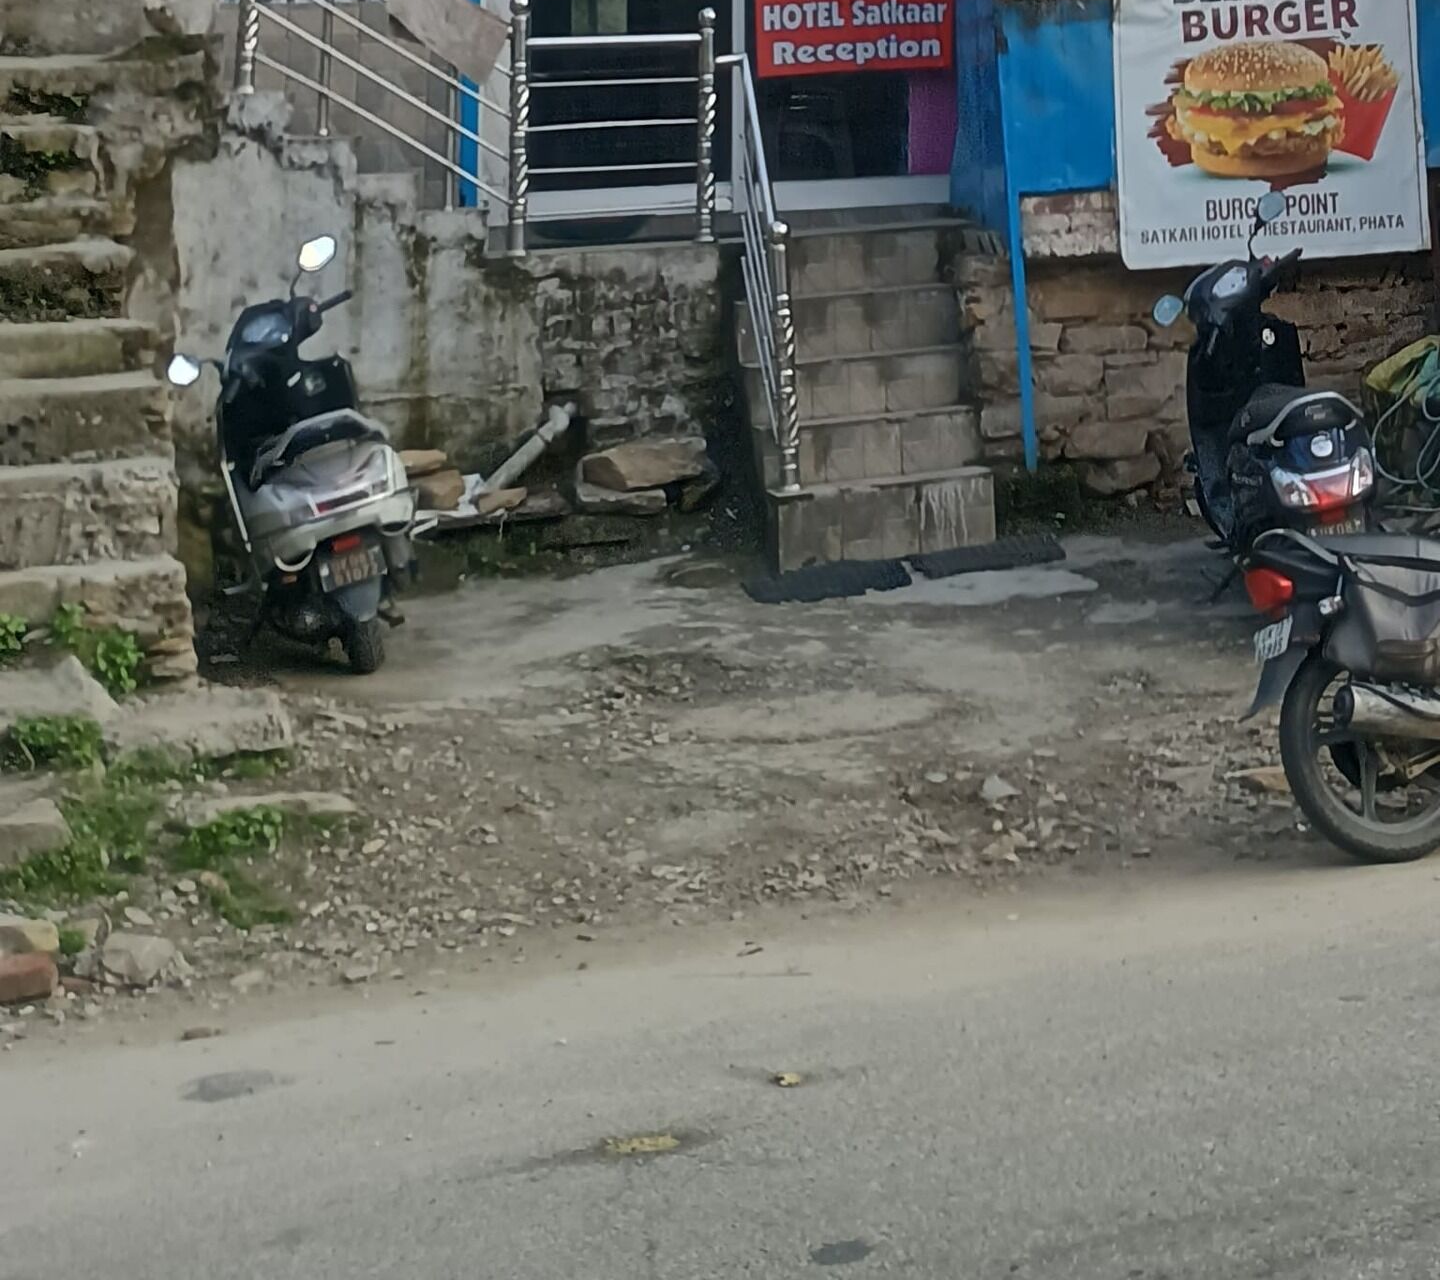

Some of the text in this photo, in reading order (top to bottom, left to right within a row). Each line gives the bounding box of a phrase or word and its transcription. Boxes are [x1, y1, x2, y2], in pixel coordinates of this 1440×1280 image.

[763, 1, 845, 32] HOTEL
[772, 34, 941, 65] Reception
[1206, 192, 1339, 222] BURG POINT
[1201, 222, 1244, 241] HOTEL
[1359, 214, 1405, 231] PHATA
